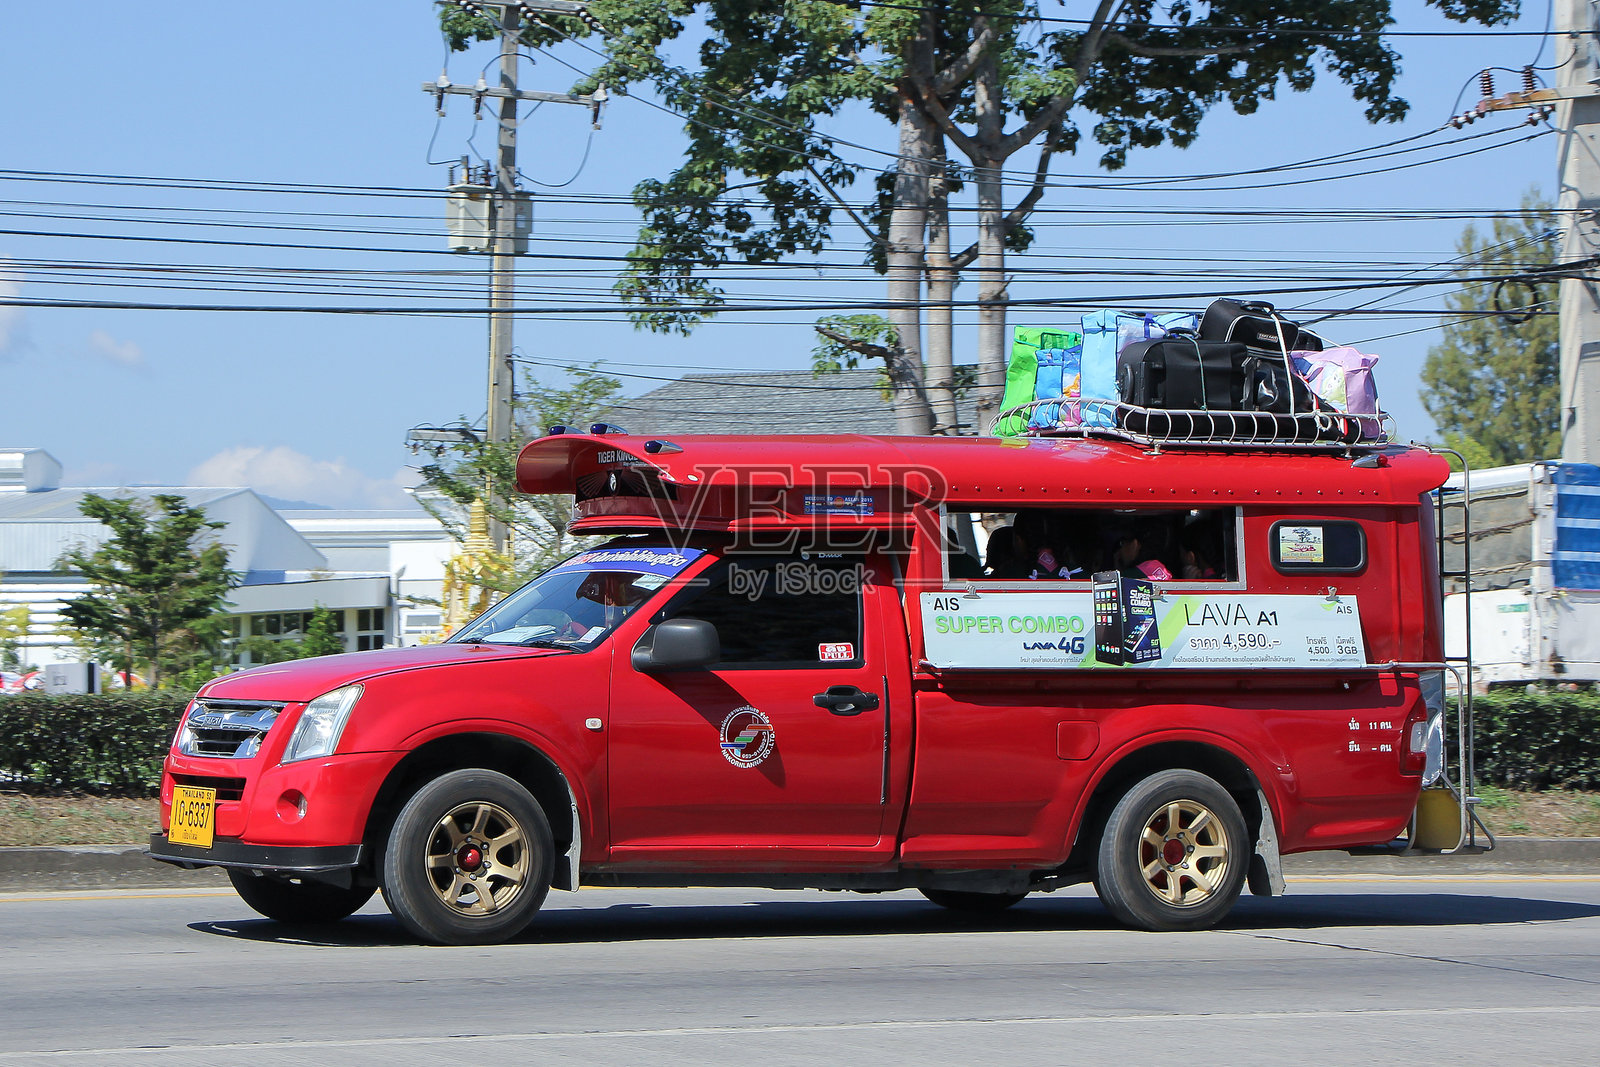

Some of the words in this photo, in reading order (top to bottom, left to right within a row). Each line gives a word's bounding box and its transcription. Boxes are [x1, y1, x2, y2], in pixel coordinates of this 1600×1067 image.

[598, 451, 615, 463] TIGER
[1130, 589, 1150, 600] SUPER
[934, 597, 960, 611] AIS
[1130, 599, 1151, 607] COMBO
[1184, 603, 1251, 626] LAVA
[1257, 611, 1279, 626] A1
[1336, 606, 1353, 614] AIS
[935, 615, 1003, 634] SUPER
[1008, 615, 1084, 634] COMBO
[1023, 641, 1057, 650] LAVA
[1058, 636, 1085, 655] 4G
[1190, 637, 1219, 649] ราคา
[1337, 645, 1358, 654] 3GB
[1348, 717, 1360, 730] นั่ง
[1368, 722, 1377, 730] 11
[1380, 721, 1392, 730] คน
[1348, 741, 1360, 752] ยืน
[1380, 744, 1392, 752] คน
[182, 789, 205, 799] THAILAND
[174, 800, 211, 829] 10-6337
